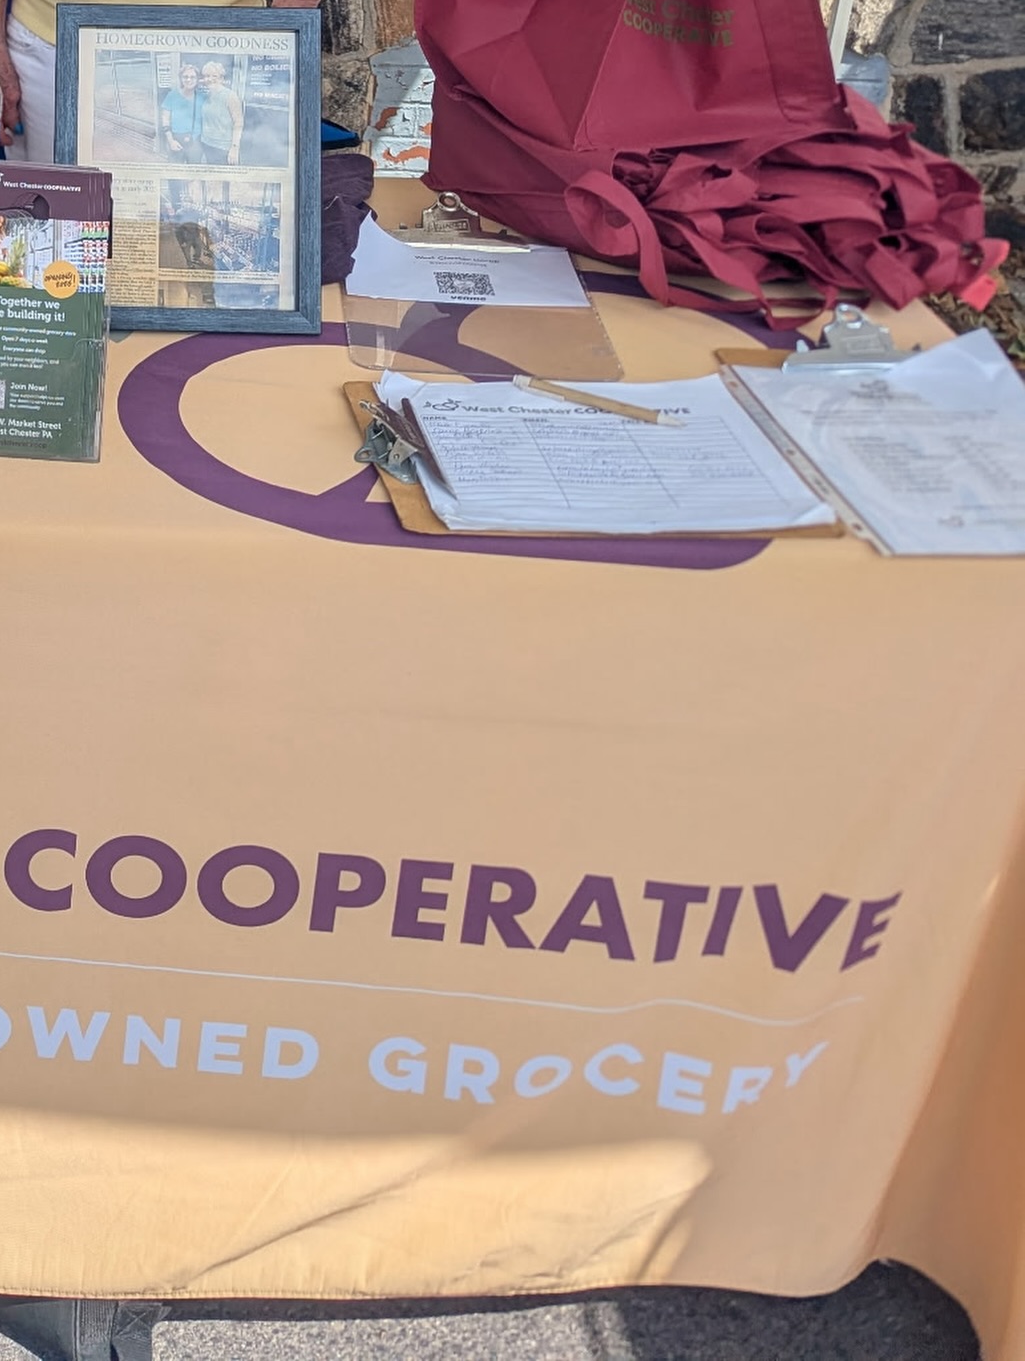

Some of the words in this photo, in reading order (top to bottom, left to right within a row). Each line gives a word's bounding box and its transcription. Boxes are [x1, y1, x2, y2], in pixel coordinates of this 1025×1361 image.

[96, 32, 203, 47] HOMEGROWN
[205, 36, 289, 51] GOODNESS
[44, 301, 60, 309] we
[7, 308, 52, 323] building
[54, 312, 66, 322] it!
[10, 382, 26, 391] Join
[28, 383, 48, 391] Now!
[462, 405, 505, 414] West
[507, 405, 572, 414] Chester
[8, 419, 36, 428] Market
[37, 421, 62, 430] Street
[8, 428, 40, 438] Chester
[42, 430, 53, 438] PA
[4, 828, 902, 974] COOPERATIVE
[368, 1037, 830, 1115] GROCERY
